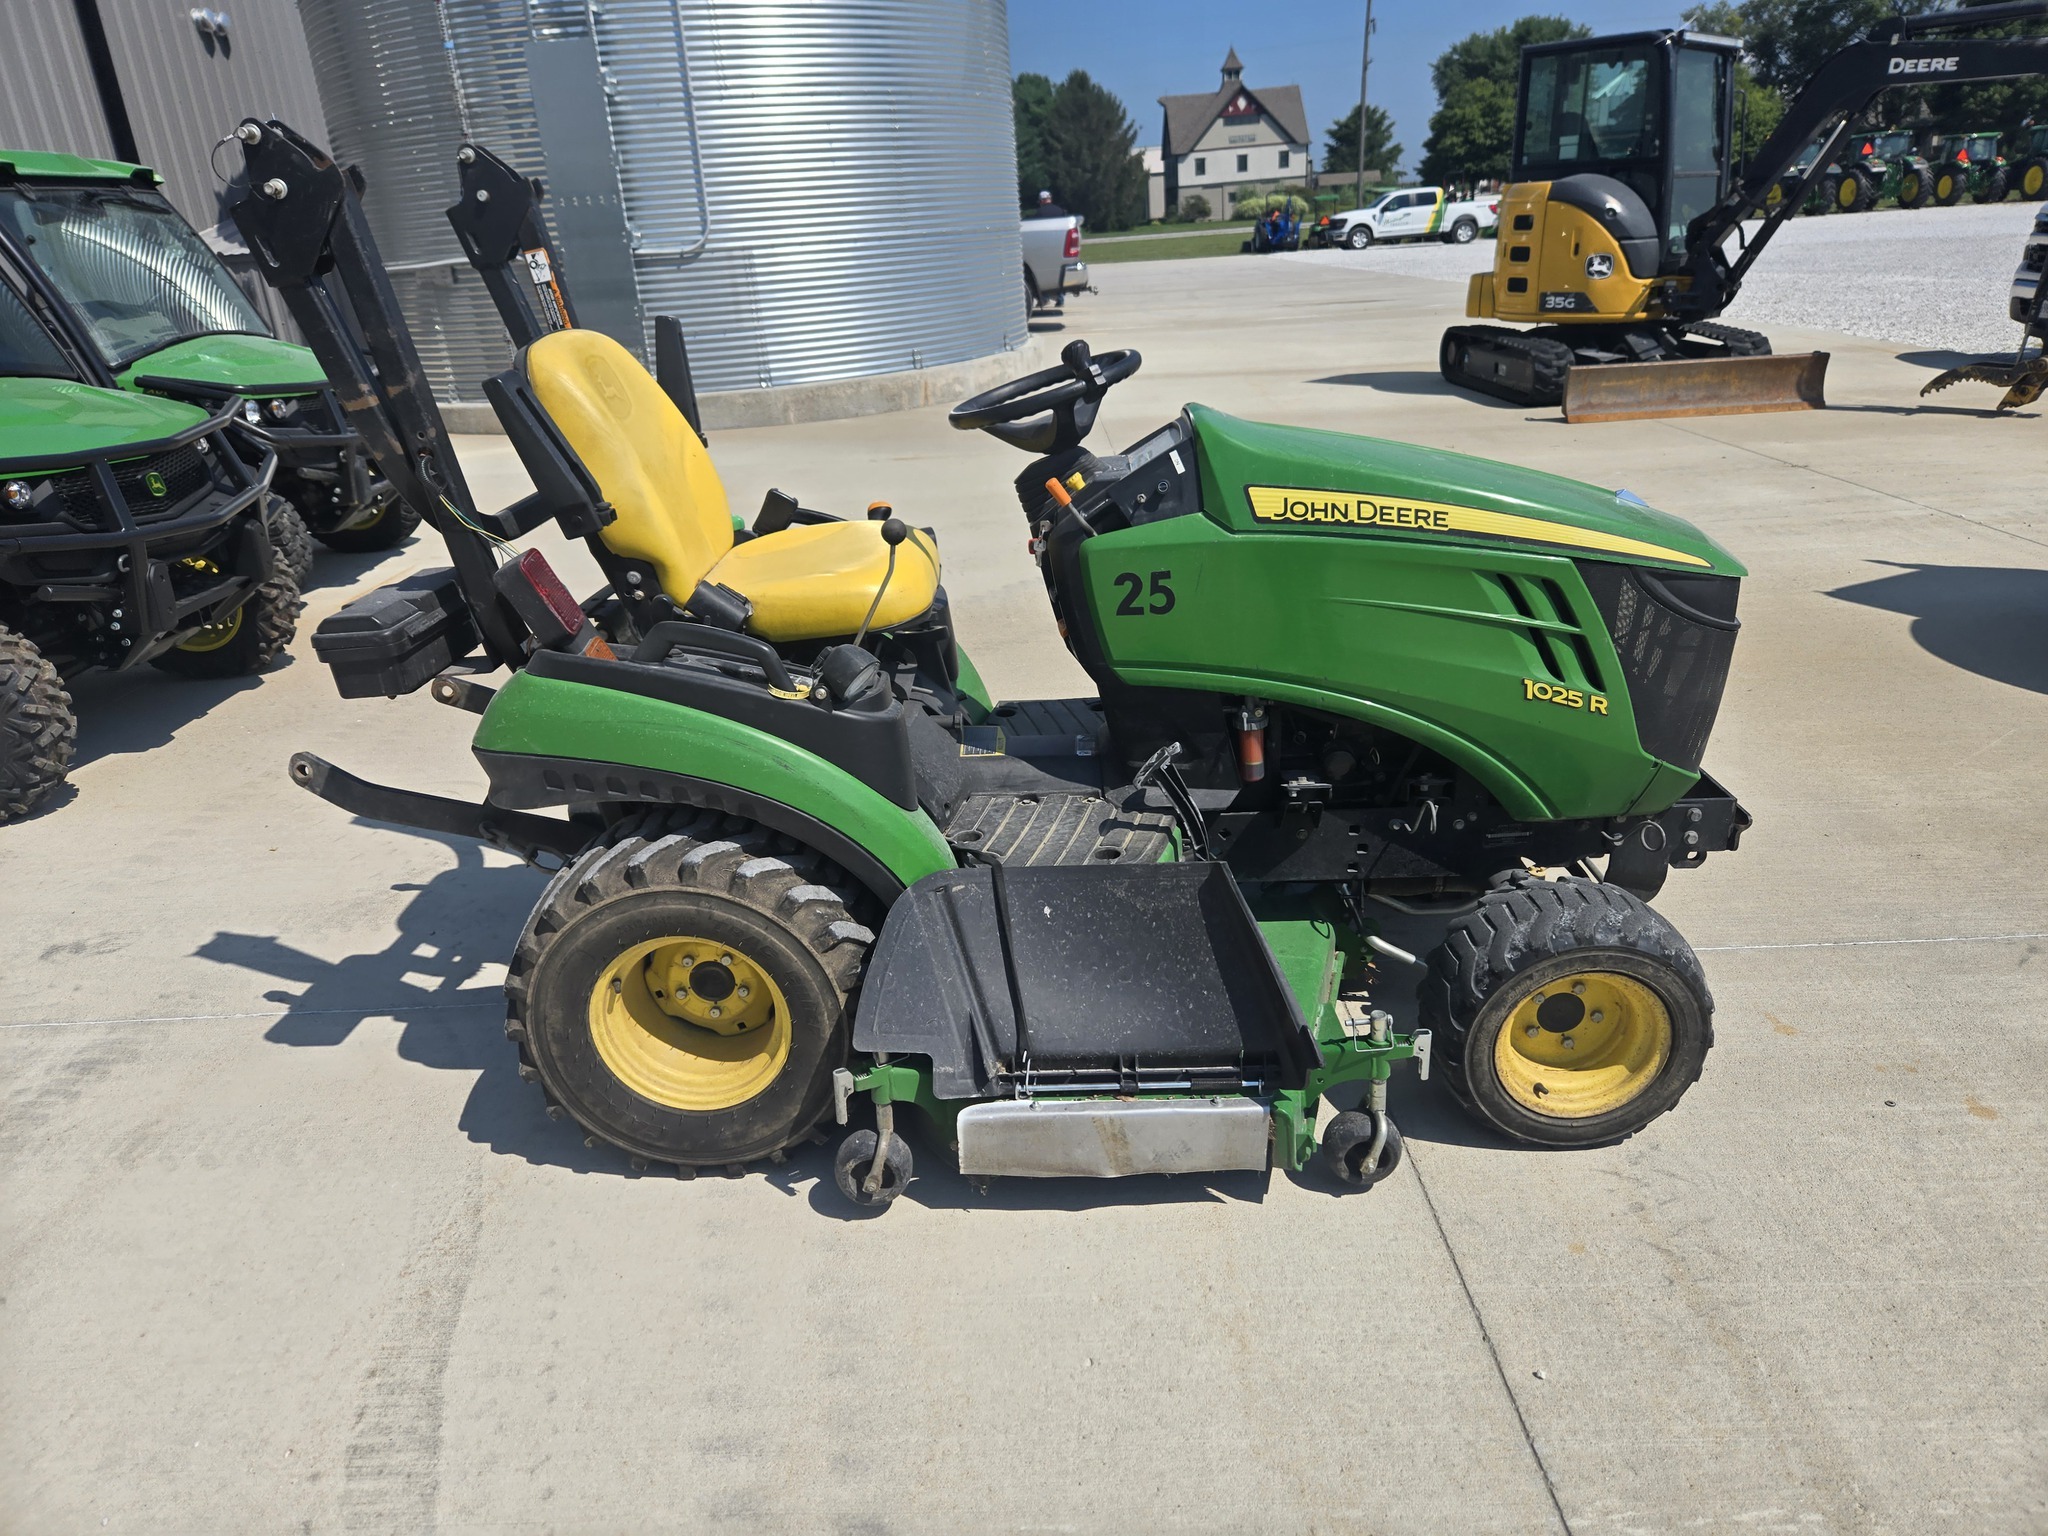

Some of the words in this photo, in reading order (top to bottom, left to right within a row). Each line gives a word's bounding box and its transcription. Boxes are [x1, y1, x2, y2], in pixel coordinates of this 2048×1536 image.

[1887, 56, 1960, 75] DEERE
[1544, 295, 1576, 309] 35G
[1273, 497, 1349, 520] JOHN
[1356, 500, 1449, 528] DEERE
[1113, 570, 1176, 616] 25
[1522, 677, 1584, 708] 1025
[1589, 694, 1608, 716] R
